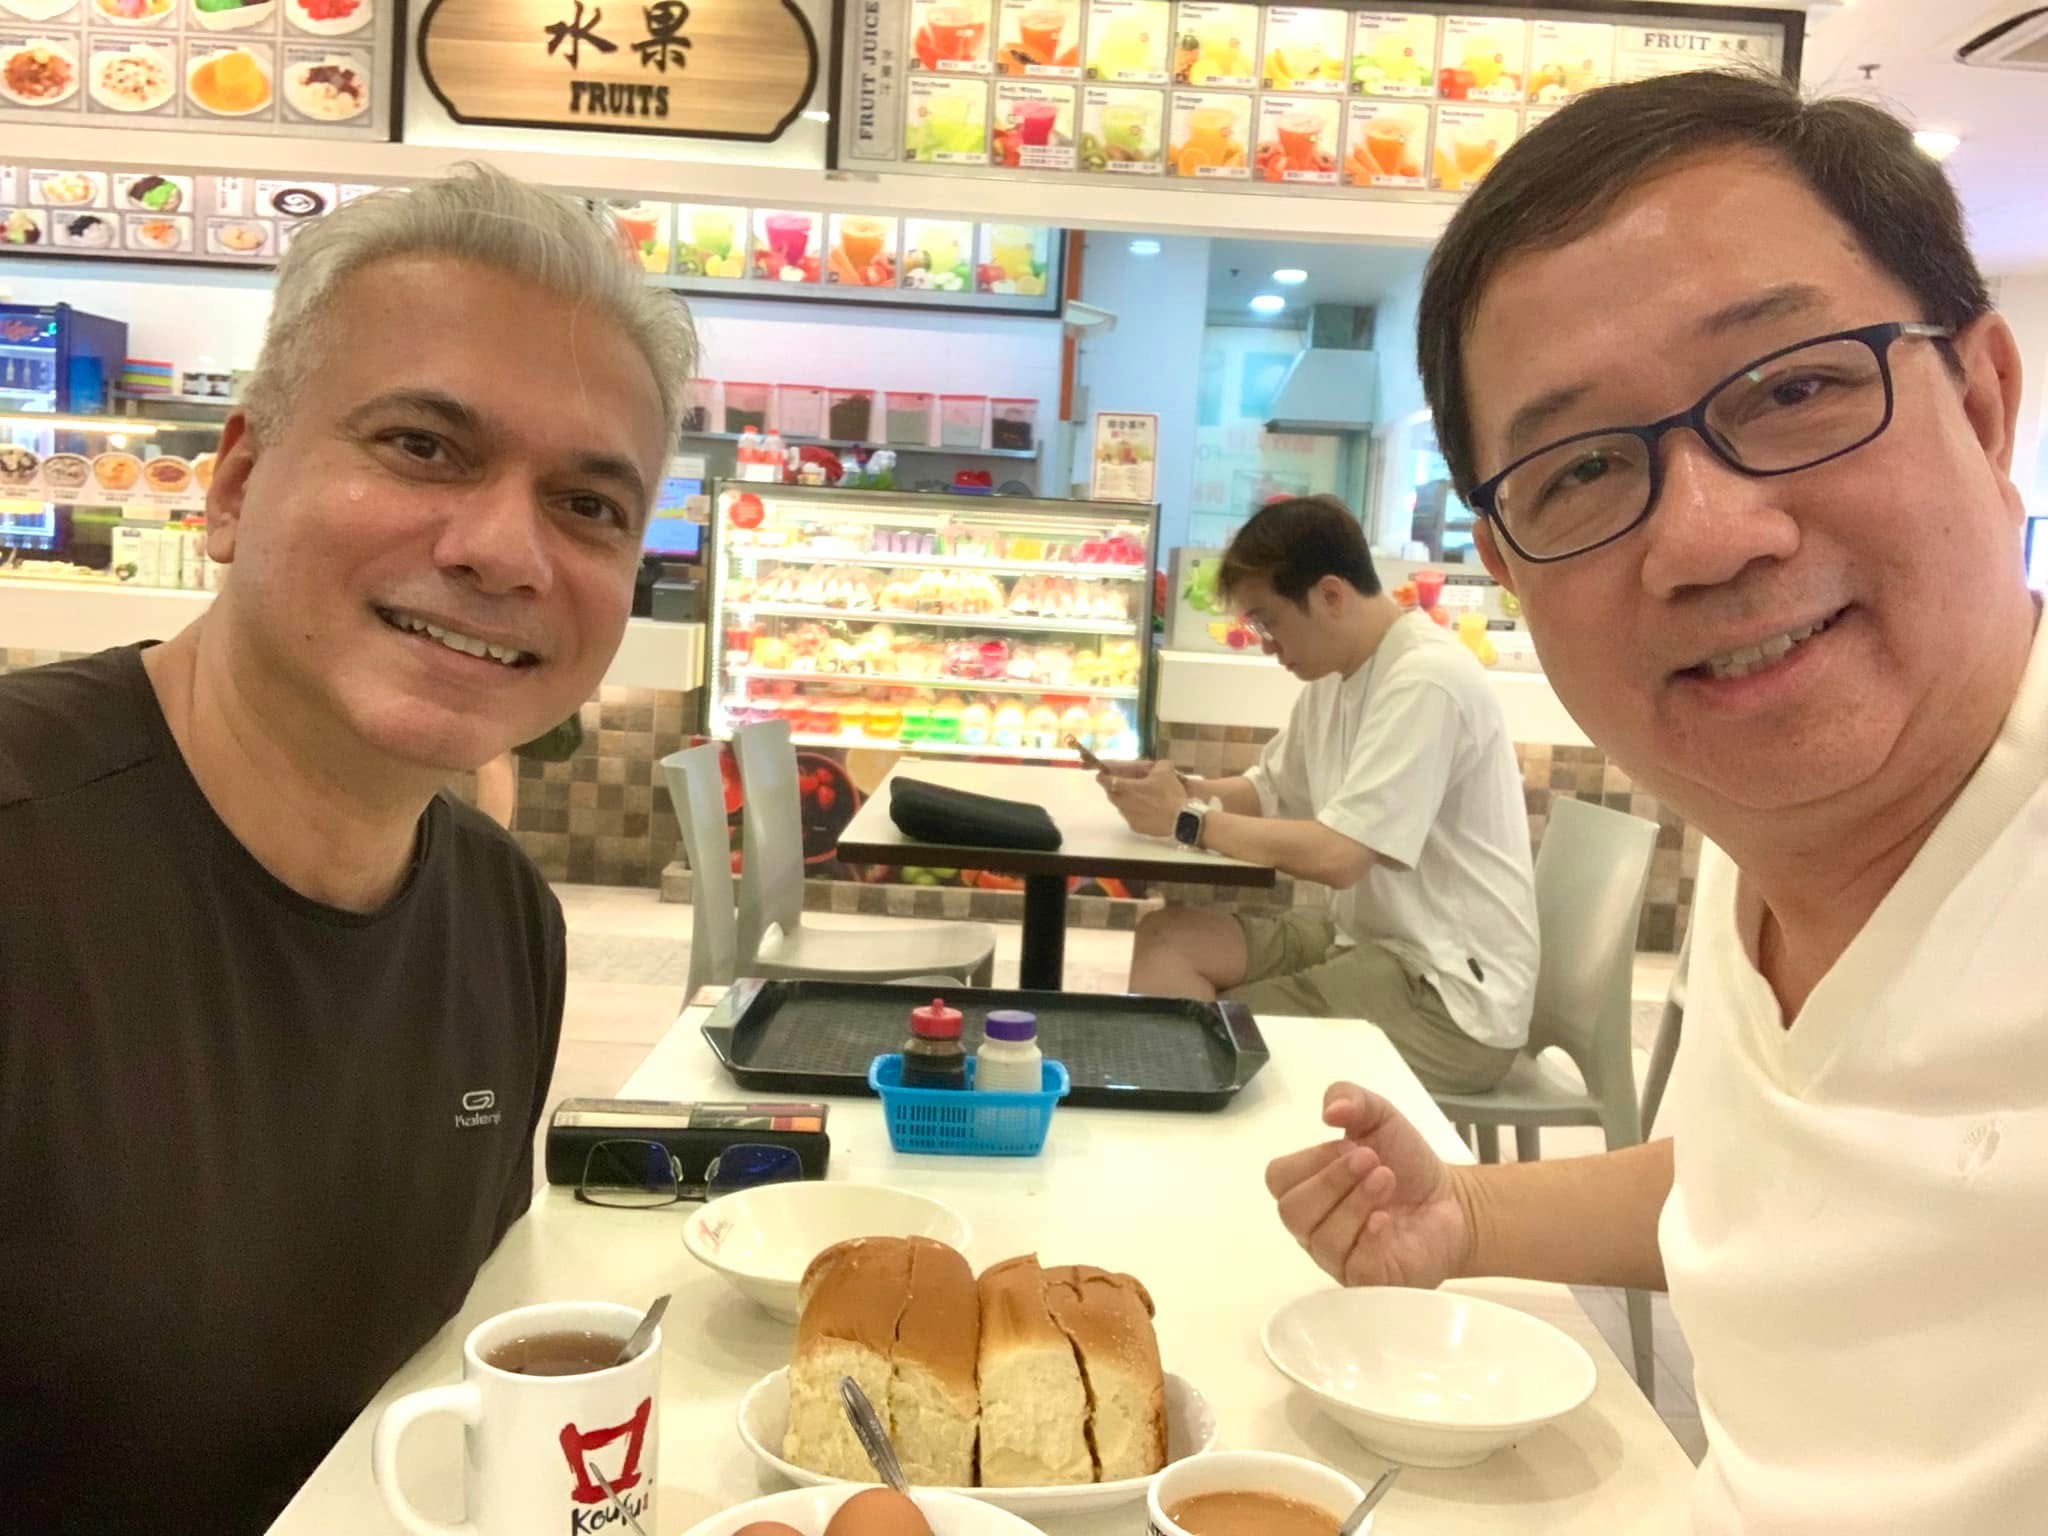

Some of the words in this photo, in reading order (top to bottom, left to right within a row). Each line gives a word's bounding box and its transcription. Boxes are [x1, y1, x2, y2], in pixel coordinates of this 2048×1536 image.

[544, 0, 692, 73] 水果
[862, 0, 879, 66] JUICE
[1644, 32, 1712, 51] FRUIT
[569, 80, 670, 117] FRUITS
[859, 72, 877, 140] FRUIT
